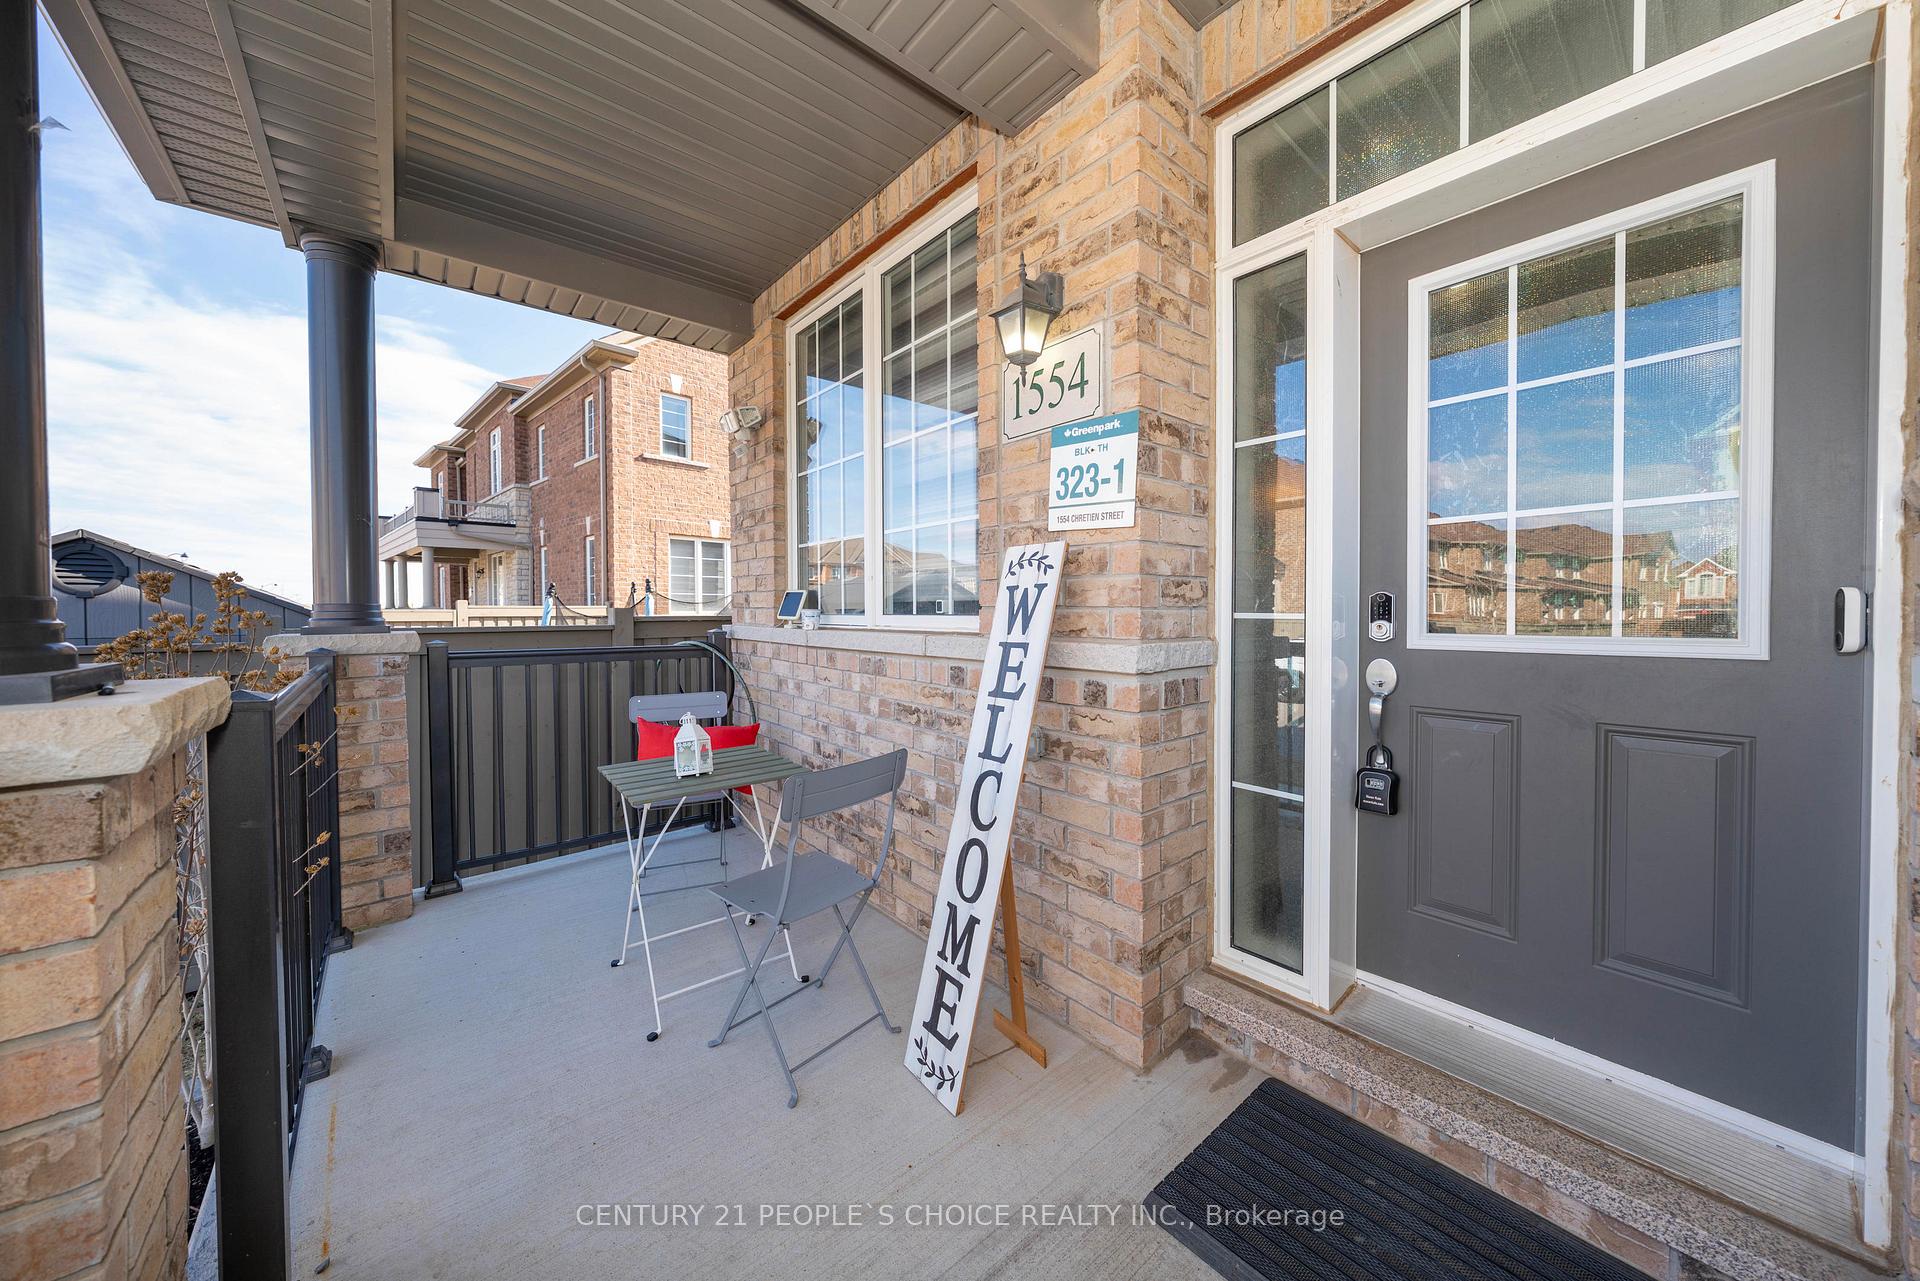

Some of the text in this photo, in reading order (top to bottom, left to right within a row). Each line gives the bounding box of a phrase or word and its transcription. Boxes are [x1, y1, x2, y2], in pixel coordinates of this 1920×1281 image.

[1012, 352, 1088, 420] 1554
[1071, 419, 1121, 436] Greenpark
[1074, 443, 1109, 456] BLK TH
[1055, 458, 1125, 501] 323-1
[1056, 510, 1124, 524] 1554 CHRETIEN STREET
[922, 583, 1048, 1052] WELCOME
